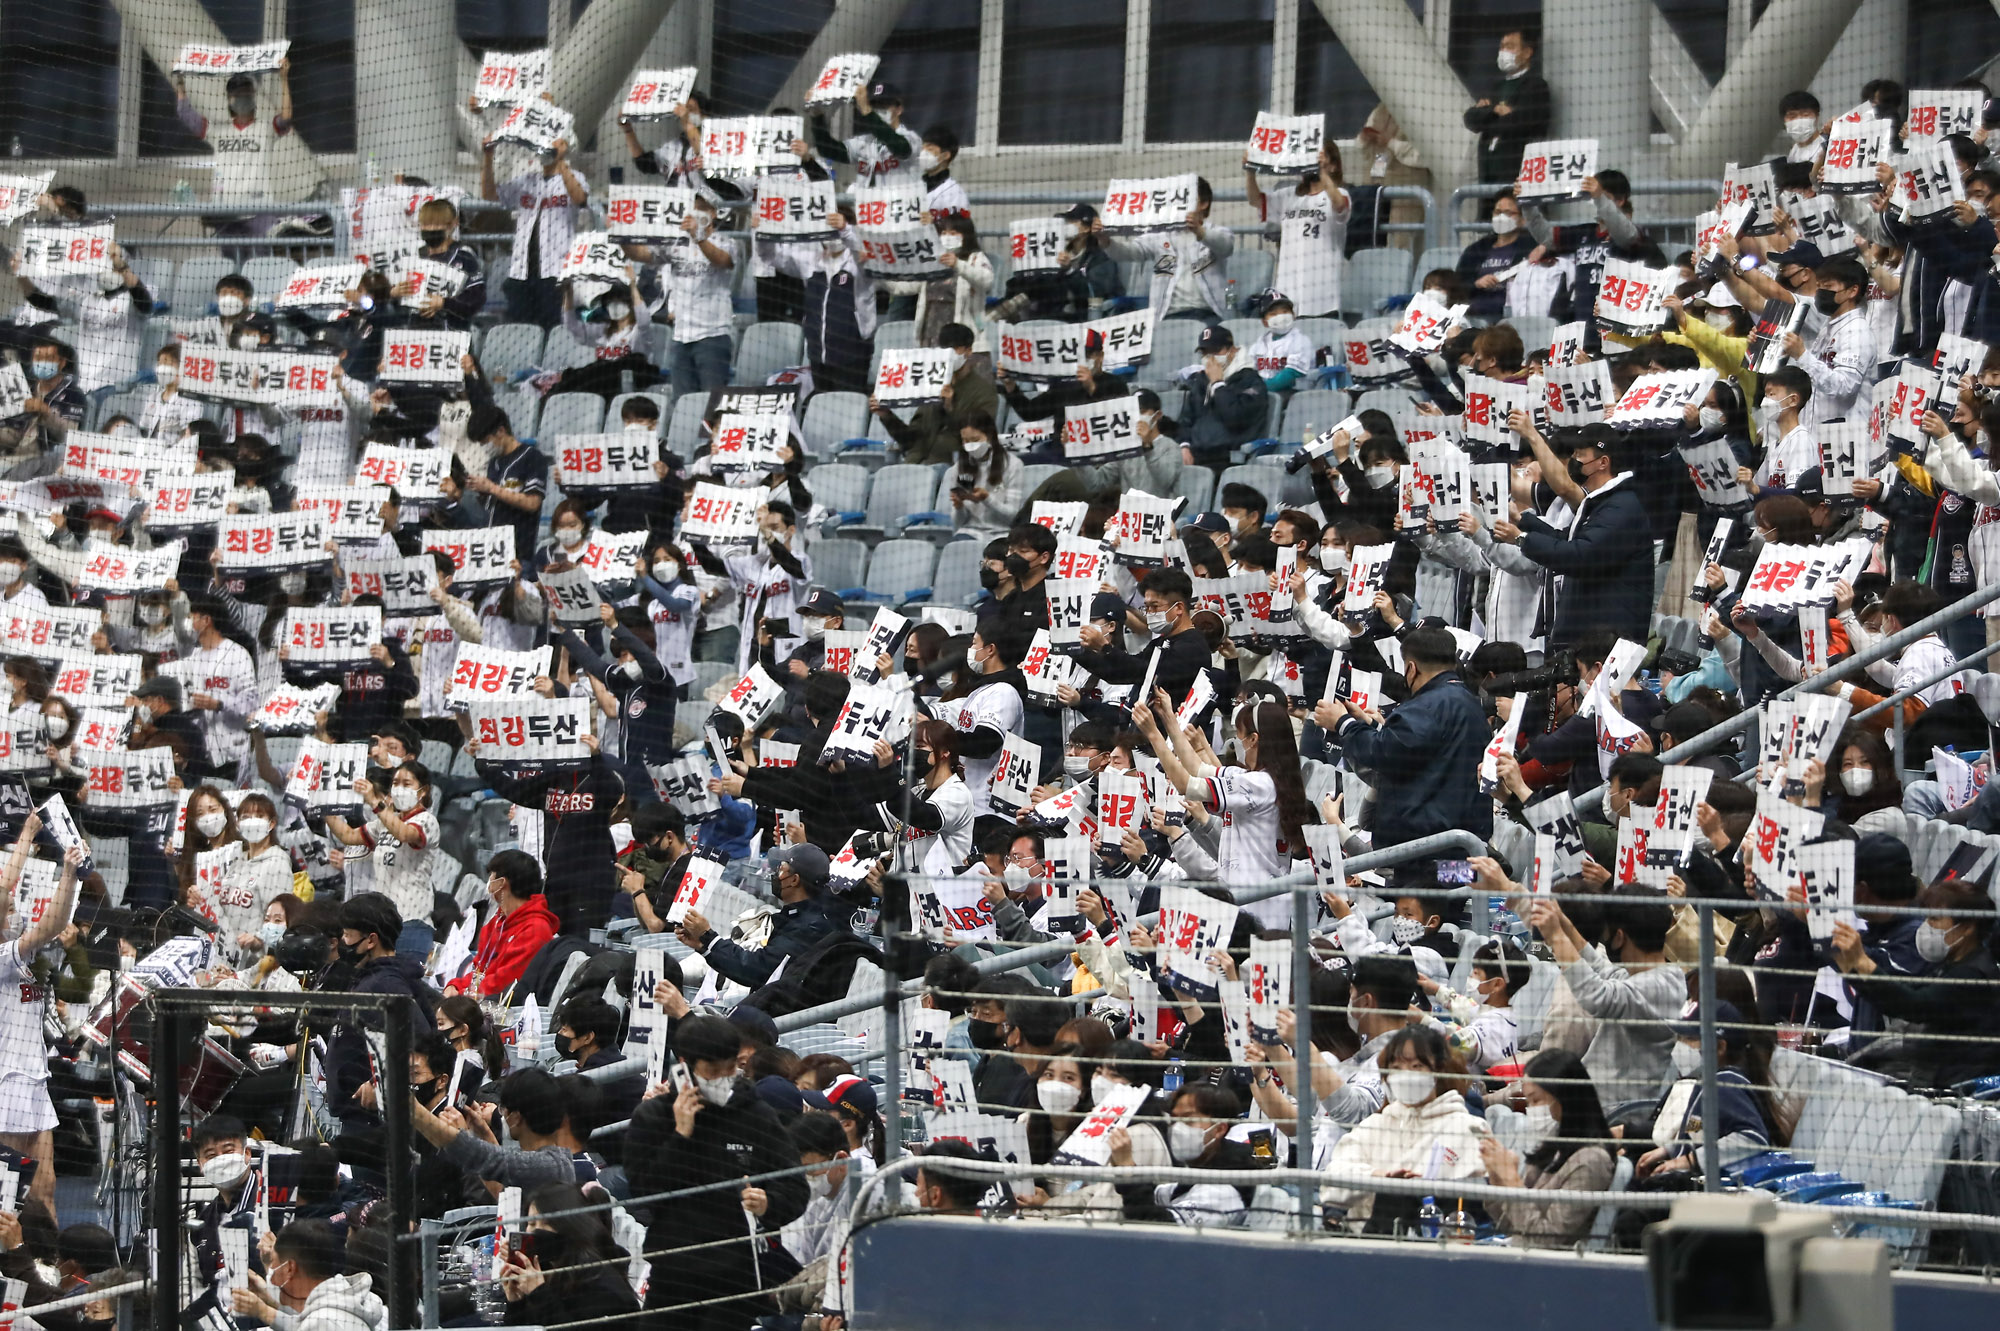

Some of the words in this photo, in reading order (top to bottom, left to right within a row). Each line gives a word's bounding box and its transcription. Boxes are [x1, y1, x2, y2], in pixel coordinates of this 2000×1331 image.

[1303, 223, 1321, 240] 24
[1256, 356, 1288, 371] EARS
[478, 713, 579, 746] 최강두산
[943, 896, 993, 931] ARS
